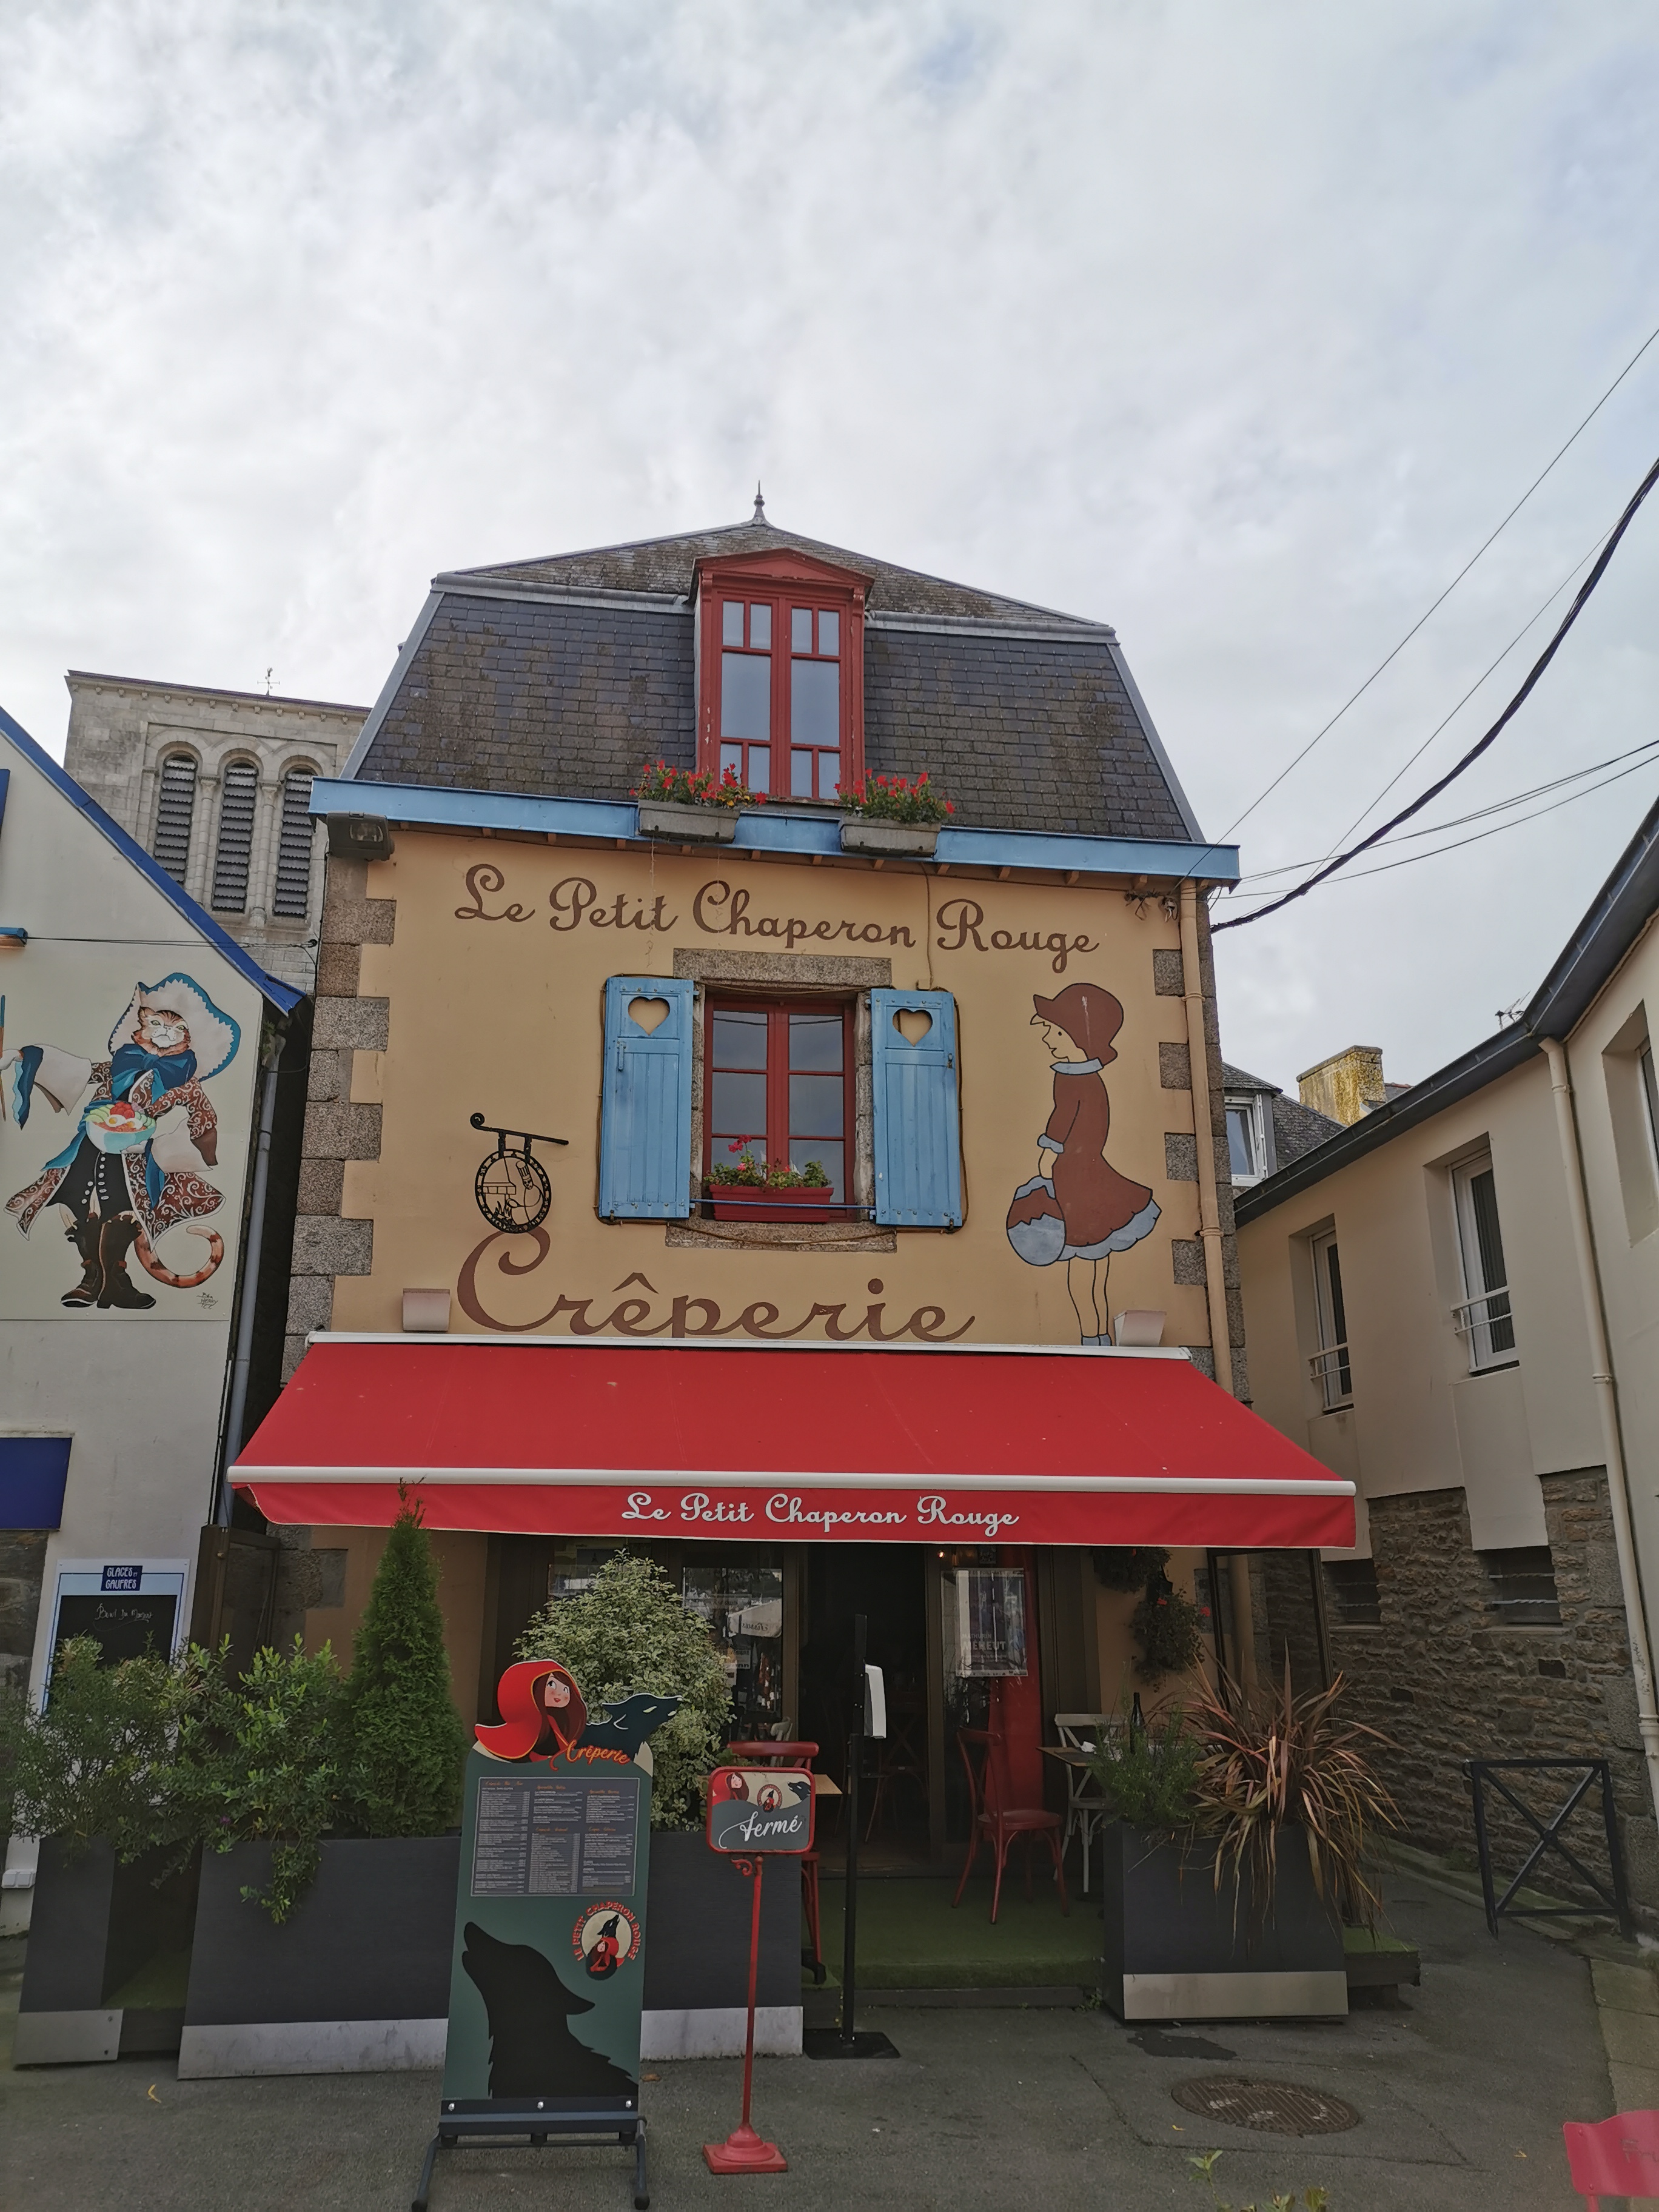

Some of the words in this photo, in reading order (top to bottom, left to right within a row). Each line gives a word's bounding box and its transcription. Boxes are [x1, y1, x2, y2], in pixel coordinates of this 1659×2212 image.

[454, 863, 535, 922] Le
[549, 877, 679, 931] Petit
[692, 880, 916, 949] Chaperon
[936, 899, 1099, 974] Rouge
[457, 1226, 976, 1342] Crêperie
[622, 1492, 671, 1521] Le
[680, 1492, 754, 1523] Petit
[765, 1493, 907, 1533] Chaperon
[917, 1495, 1020, 1537] Rouge
[105, 1579, 137, 1589] GAUFRES
[107, 1567, 133, 1578] GLACES
[549, 1739, 631, 1771] Crêperie
[586, 1900, 636, 1922] CHAPERON
[572, 1915, 586, 1945] PETIT
[627, 1922, 641, 1960] ROUGE
[573, 1947, 585, 1961] LE
